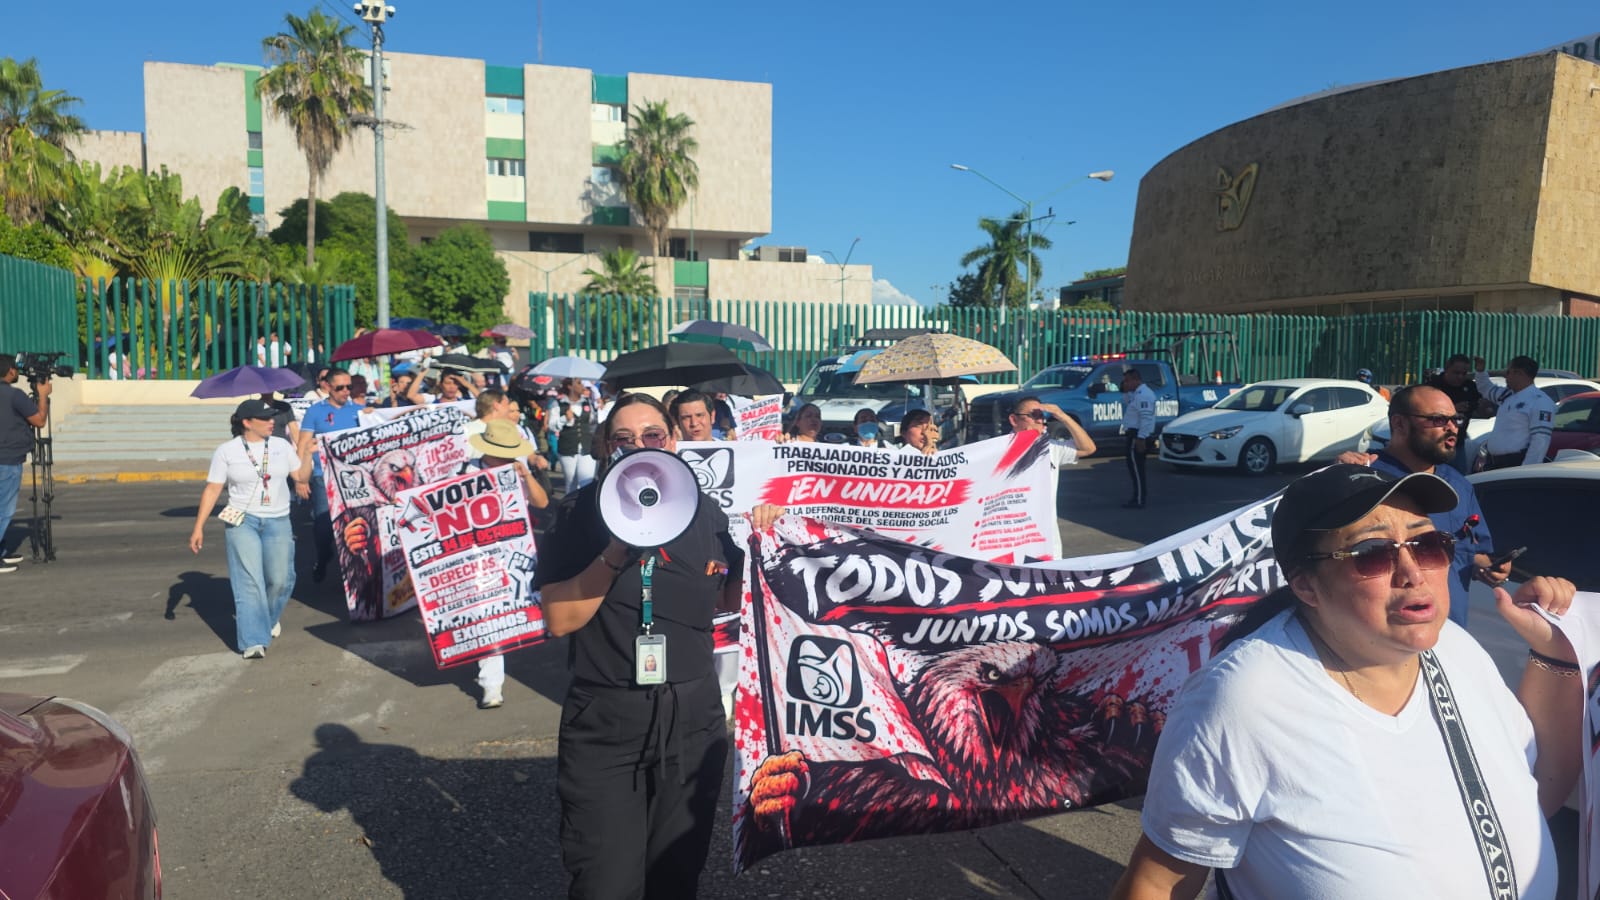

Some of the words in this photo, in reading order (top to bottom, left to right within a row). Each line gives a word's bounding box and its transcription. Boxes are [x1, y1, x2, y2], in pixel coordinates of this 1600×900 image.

[1093, 401, 1122, 421] POLICÍA
[1155, 397, 1179, 416] RÁNSITO
[332, 433, 370, 455] TODOS
[372, 421, 409, 441] SOMOS
[409, 410, 448, 431] IMSS
[345, 445, 373, 463] JUNTOS
[377, 439, 400, 452] SOMOS
[401, 434, 420, 446] MÁS
[773, 446, 890, 465] TRABAJADORES
[894, 451, 969, 468] JUBILADOS,
[787, 460, 887, 477] PENSIONADOS
[892, 467, 900, 478] Y
[904, 467, 957, 480] ACTIVOS
[344, 489, 370, 500] IMSS
[426, 475, 493, 511] VOTA
[787, 477, 836, 506] ¡EN
[840, 480, 954, 506] UNIDAD!
[435, 495, 501, 538] NO
[792, 507, 803, 515] LA
[805, 506, 845, 516] DEFENSA
[848, 508, 859, 516] DE
[863, 509, 880, 518] LOS
[882, 509, 930, 519] DERECHOS
[932, 509, 942, 518] DE
[944, 507, 959, 516] LOS
[855, 516, 874, 526] DEL
[877, 518, 916, 528] SEGURO
[918, 517, 949, 527] SOCIAL
[411, 541, 443, 564] ESTE
[458, 532, 475, 548] DE
[476, 520, 526, 544] OCTUBRE
[418, 558, 465, 579] PROTEJAMOS
[790, 552, 962, 619] TODOS
[1156, 499, 1279, 583] IMS
[439, 607, 447, 615] LA
[447, 601, 465, 612] BASE
[902, 610, 1036, 644] JUNTOS
[1045, 602, 1138, 641] SOMOS
[1143, 587, 1197, 626] MÁS
[452, 611, 528, 644] EXIGIMOS
[786, 701, 877, 743] IMSS
